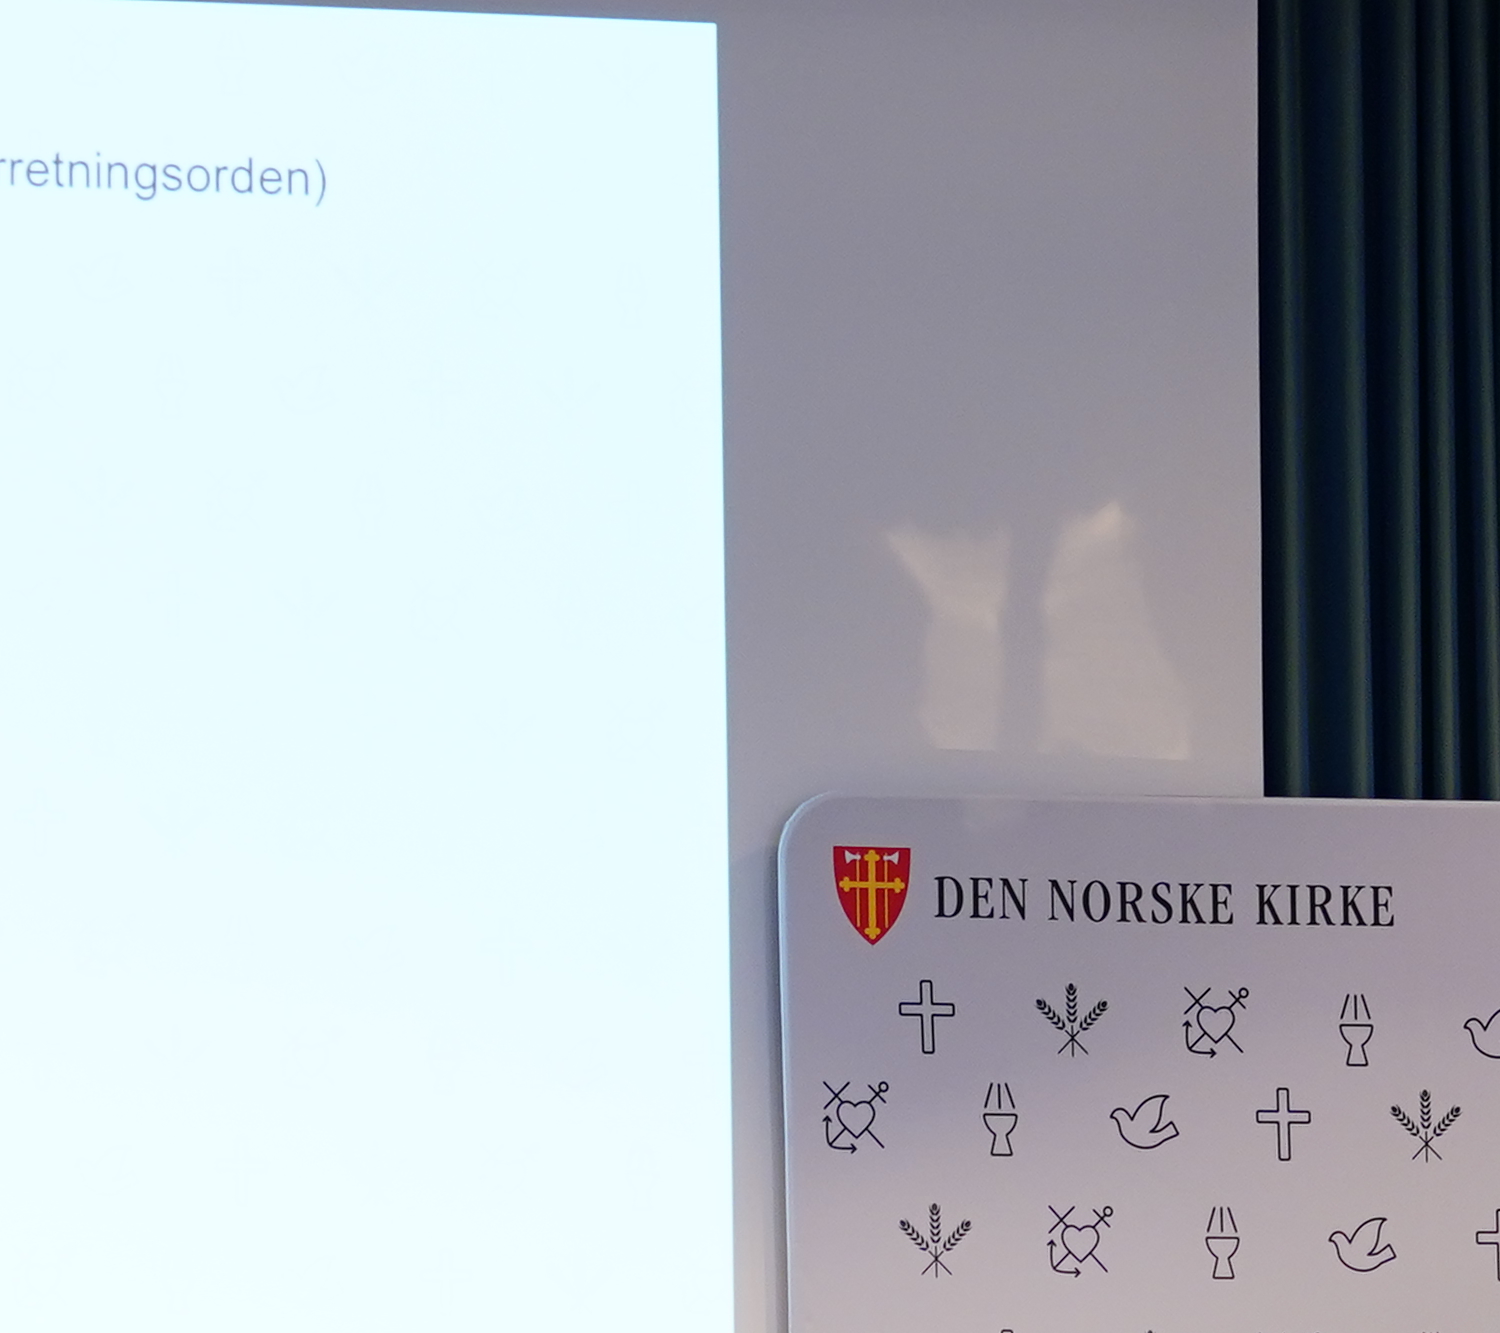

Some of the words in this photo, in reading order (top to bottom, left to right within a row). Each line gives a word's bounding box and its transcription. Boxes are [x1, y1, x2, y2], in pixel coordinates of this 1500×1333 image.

[932, 875, 1029, 922] DEN
[1047, 878, 1235, 926] NORSKE
[1254, 883, 1396, 928] KIRKE
